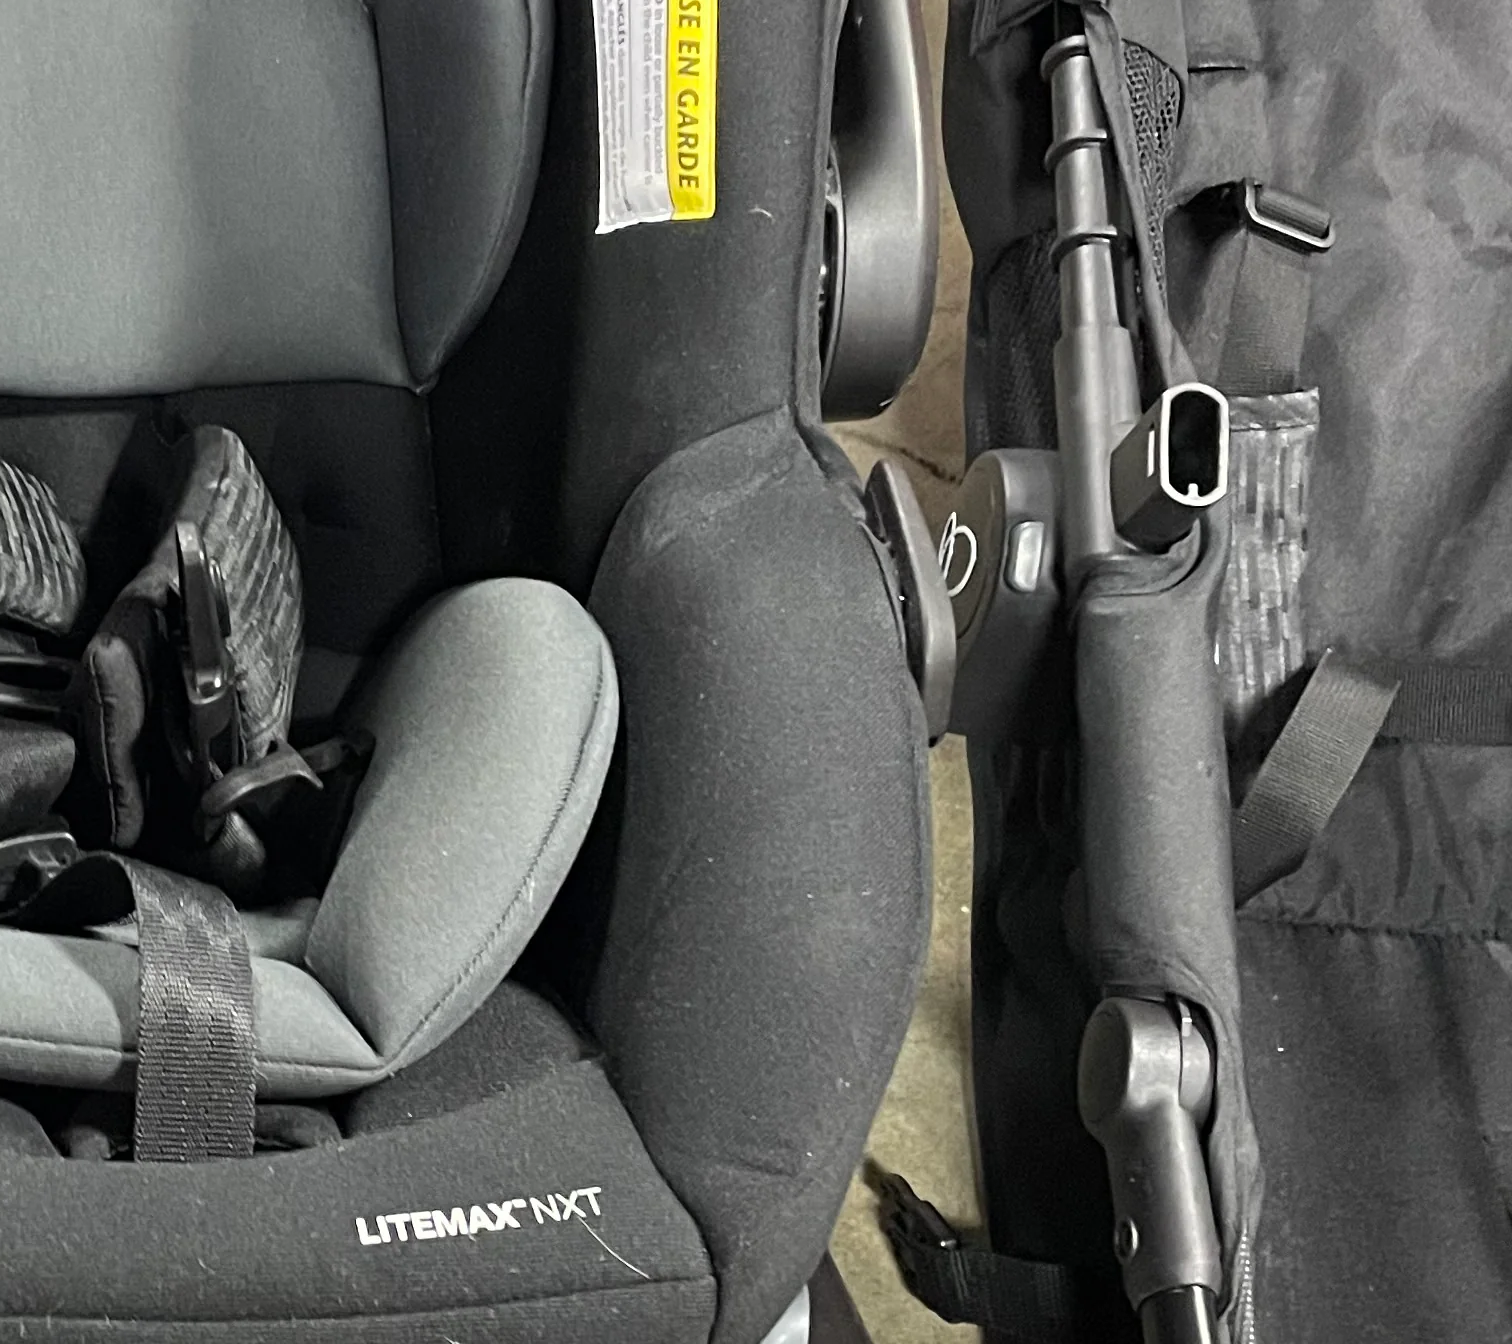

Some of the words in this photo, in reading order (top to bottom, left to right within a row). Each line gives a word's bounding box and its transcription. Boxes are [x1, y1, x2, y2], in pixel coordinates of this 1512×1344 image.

[678, 40, 700, 76] EN
[677, 88, 700, 188] GARDE
[529, 1186, 602, 1224] NXT
